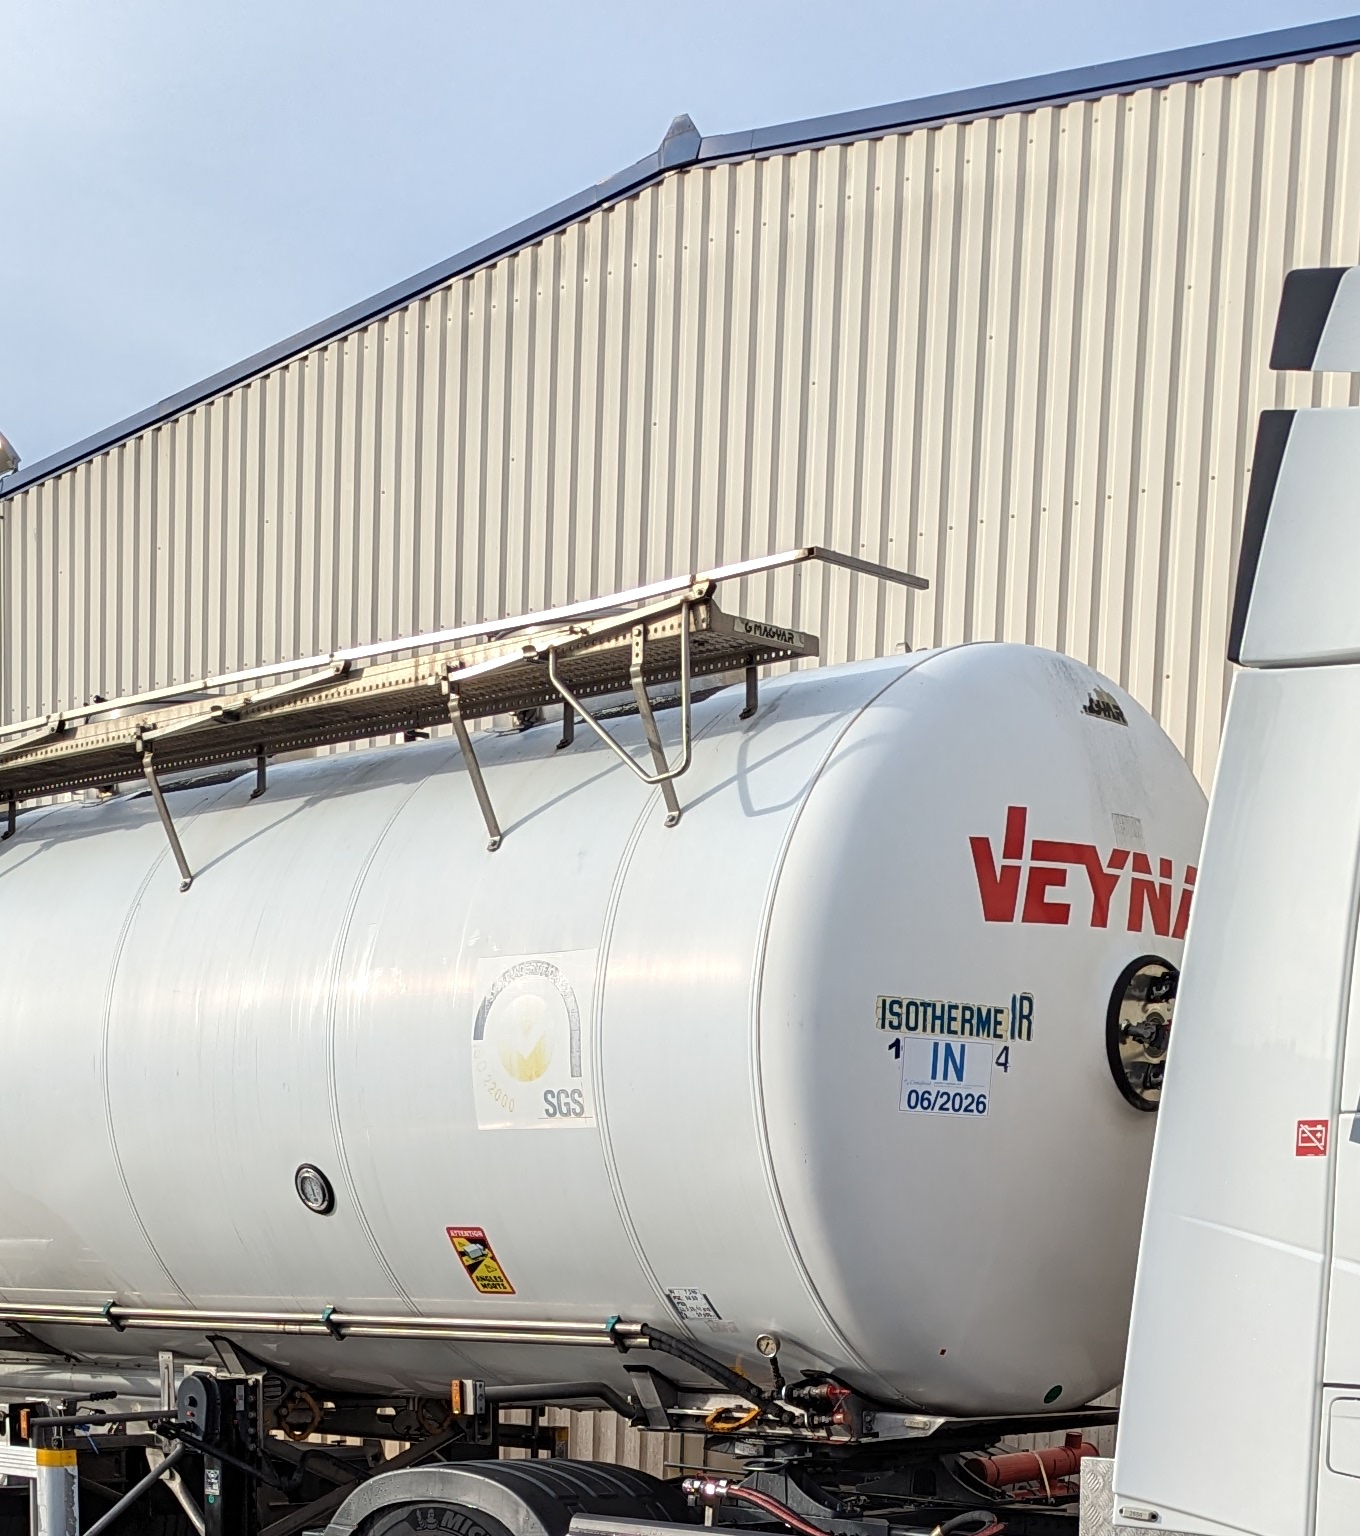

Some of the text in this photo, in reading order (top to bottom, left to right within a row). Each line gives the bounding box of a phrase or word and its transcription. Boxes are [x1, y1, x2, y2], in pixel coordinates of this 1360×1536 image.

[880, 993, 1034, 1042] ISOTHERME IR
[887, 1037, 1010, 1083] 1 IN 4
[543, 1088, 585, 1118] SGS
[906, 1088, 988, 1115] 06/2026
